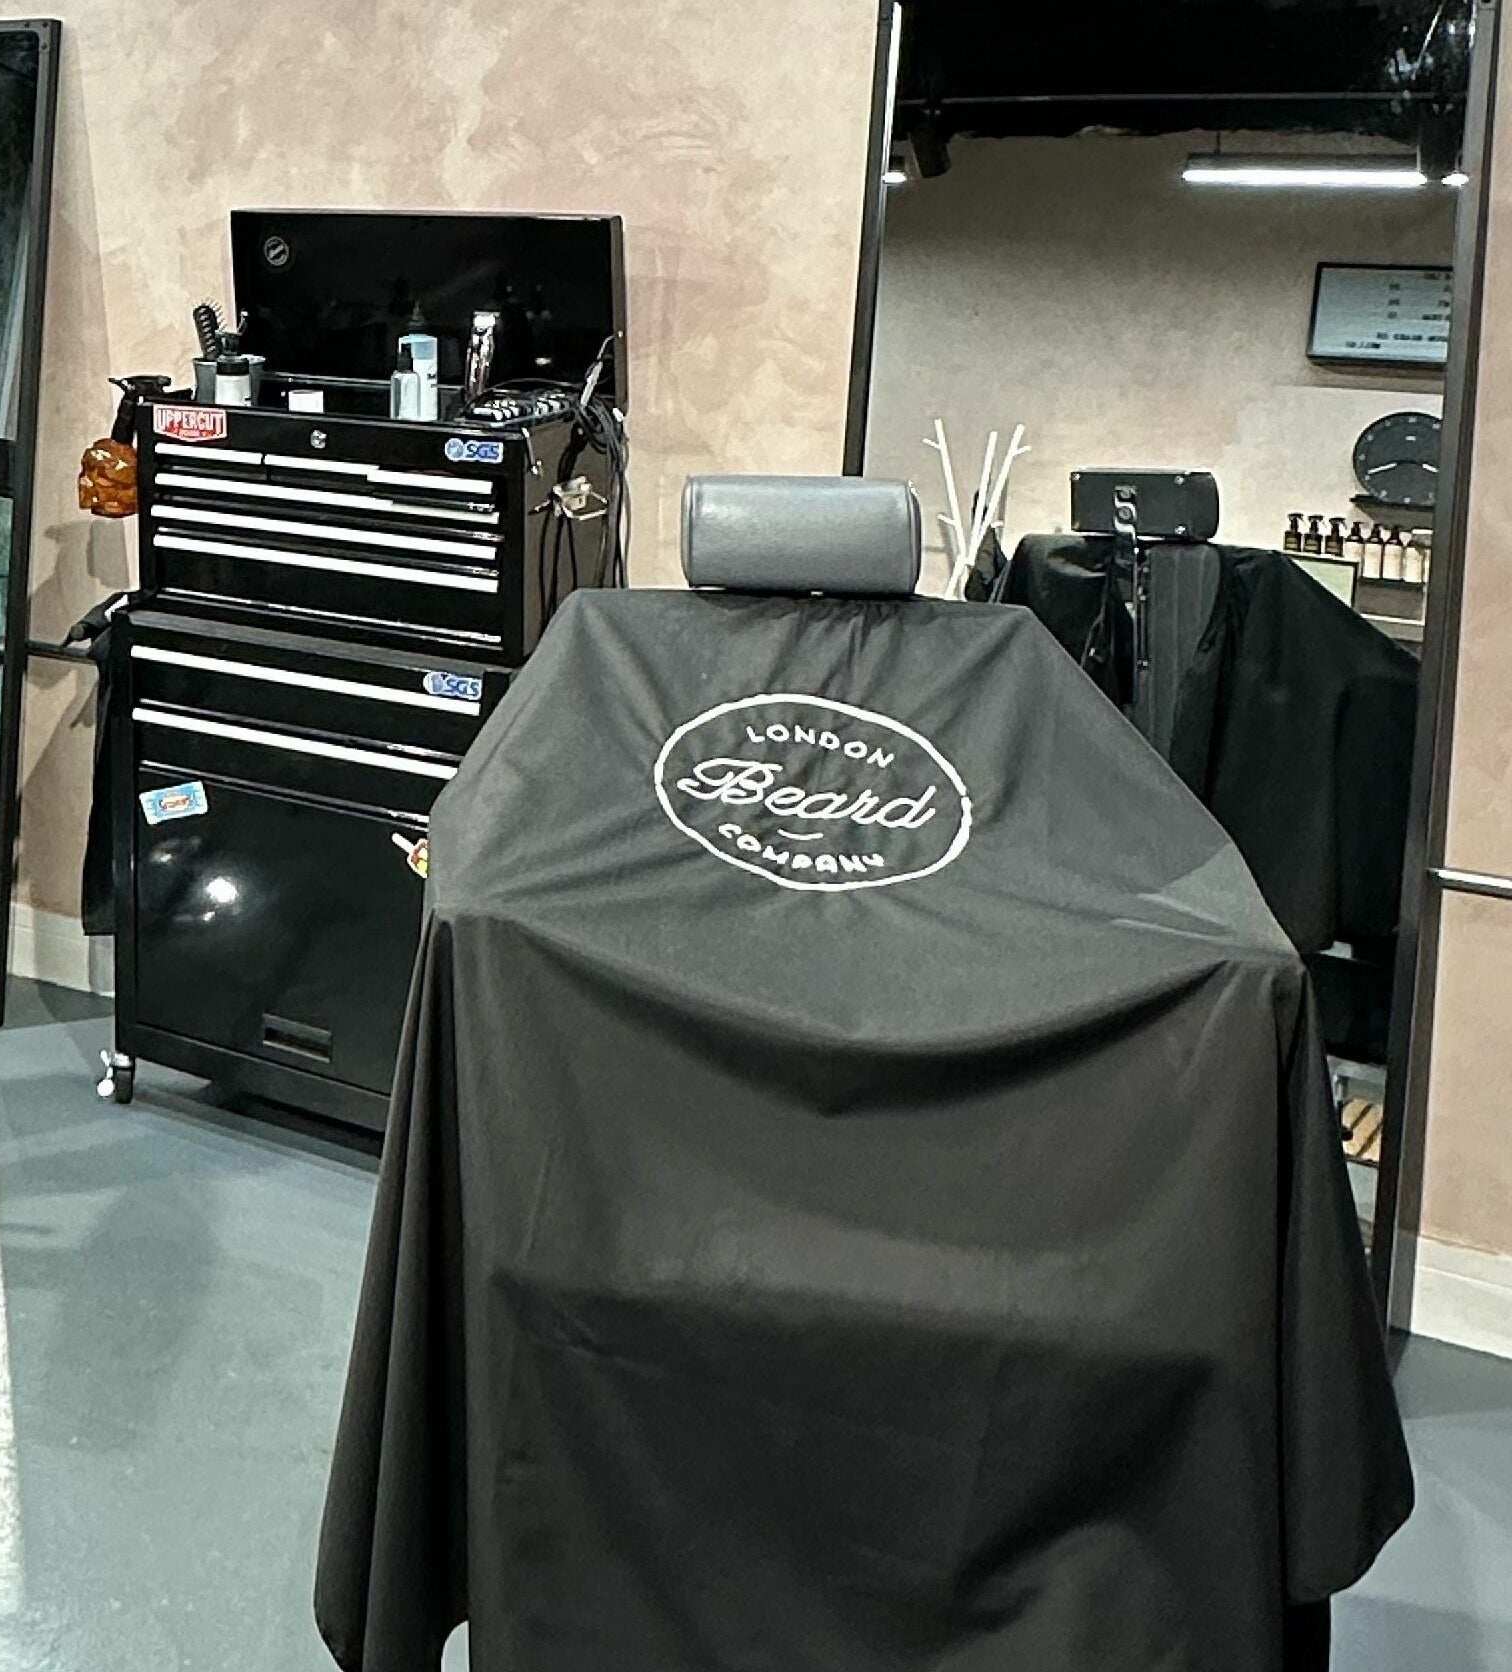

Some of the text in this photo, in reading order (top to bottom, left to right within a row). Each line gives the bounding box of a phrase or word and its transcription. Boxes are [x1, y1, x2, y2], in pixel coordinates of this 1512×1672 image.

[157, 409, 224, 434] UPPERCUT
[465, 443, 499, 460] SGS
[444, 679, 479, 696] SGS
[746, 724, 894, 768] LONDON
[677, 758, 936, 828] Beard
[718, 823, 885, 873] COMPANY
